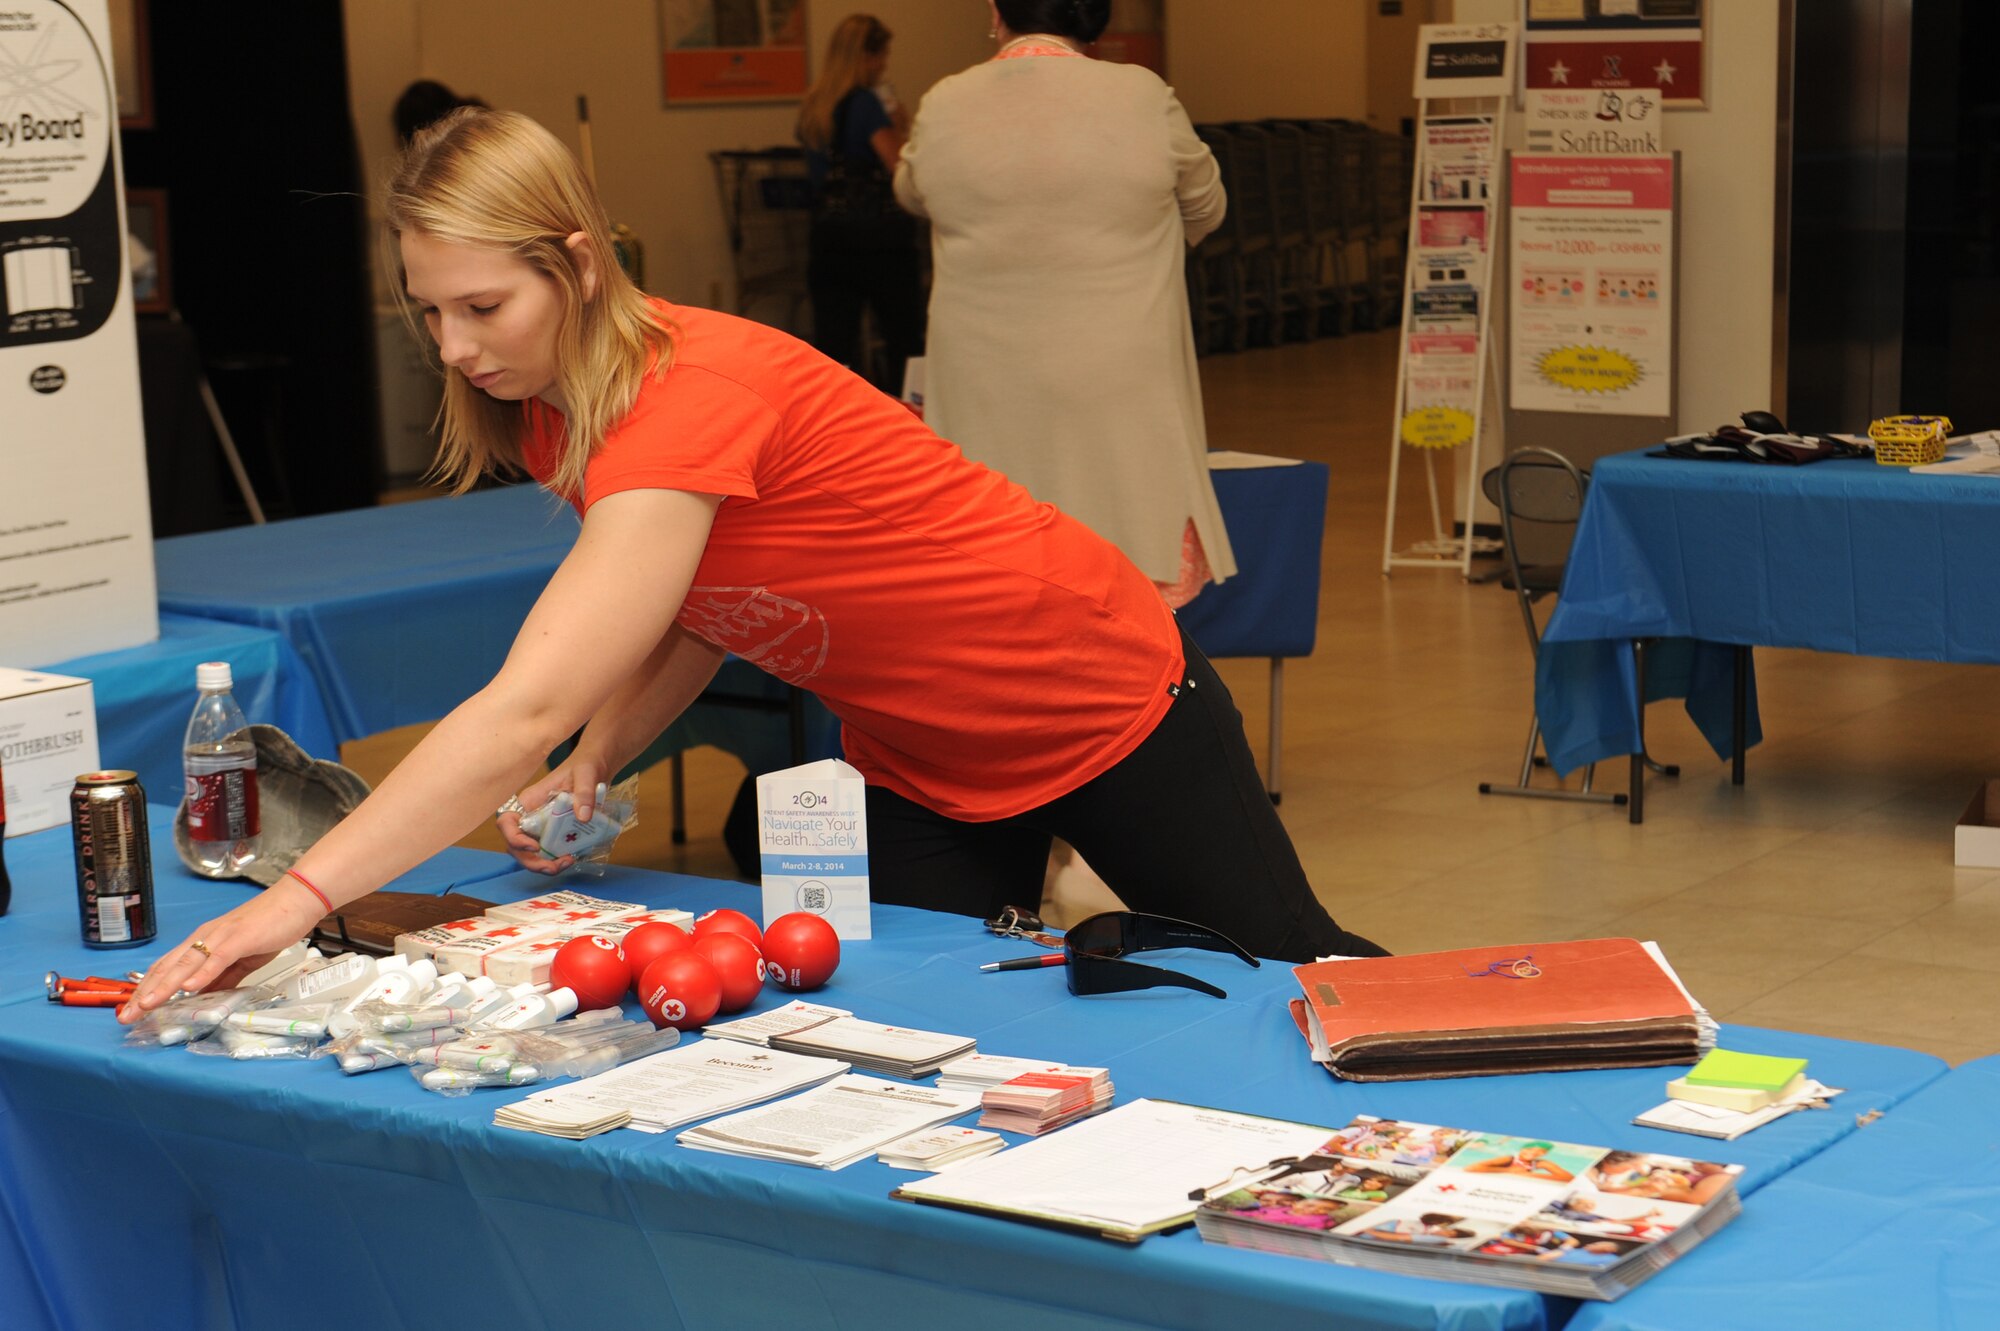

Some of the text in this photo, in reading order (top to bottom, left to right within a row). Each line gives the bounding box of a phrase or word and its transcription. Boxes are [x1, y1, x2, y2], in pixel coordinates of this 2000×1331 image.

[1448, 50, 1499, 65] SoftBank
[20, 111, 84, 141] Board
[1559, 129, 1658, 153] SoftBank
[79, 801, 93, 857] DRINK
[764, 817, 857, 833] Navigate Your
[782, 862, 844, 872] March 2-8, 2014
[84, 868, 100, 941] ENERGY
[706, 1058, 762, 1070] Become
